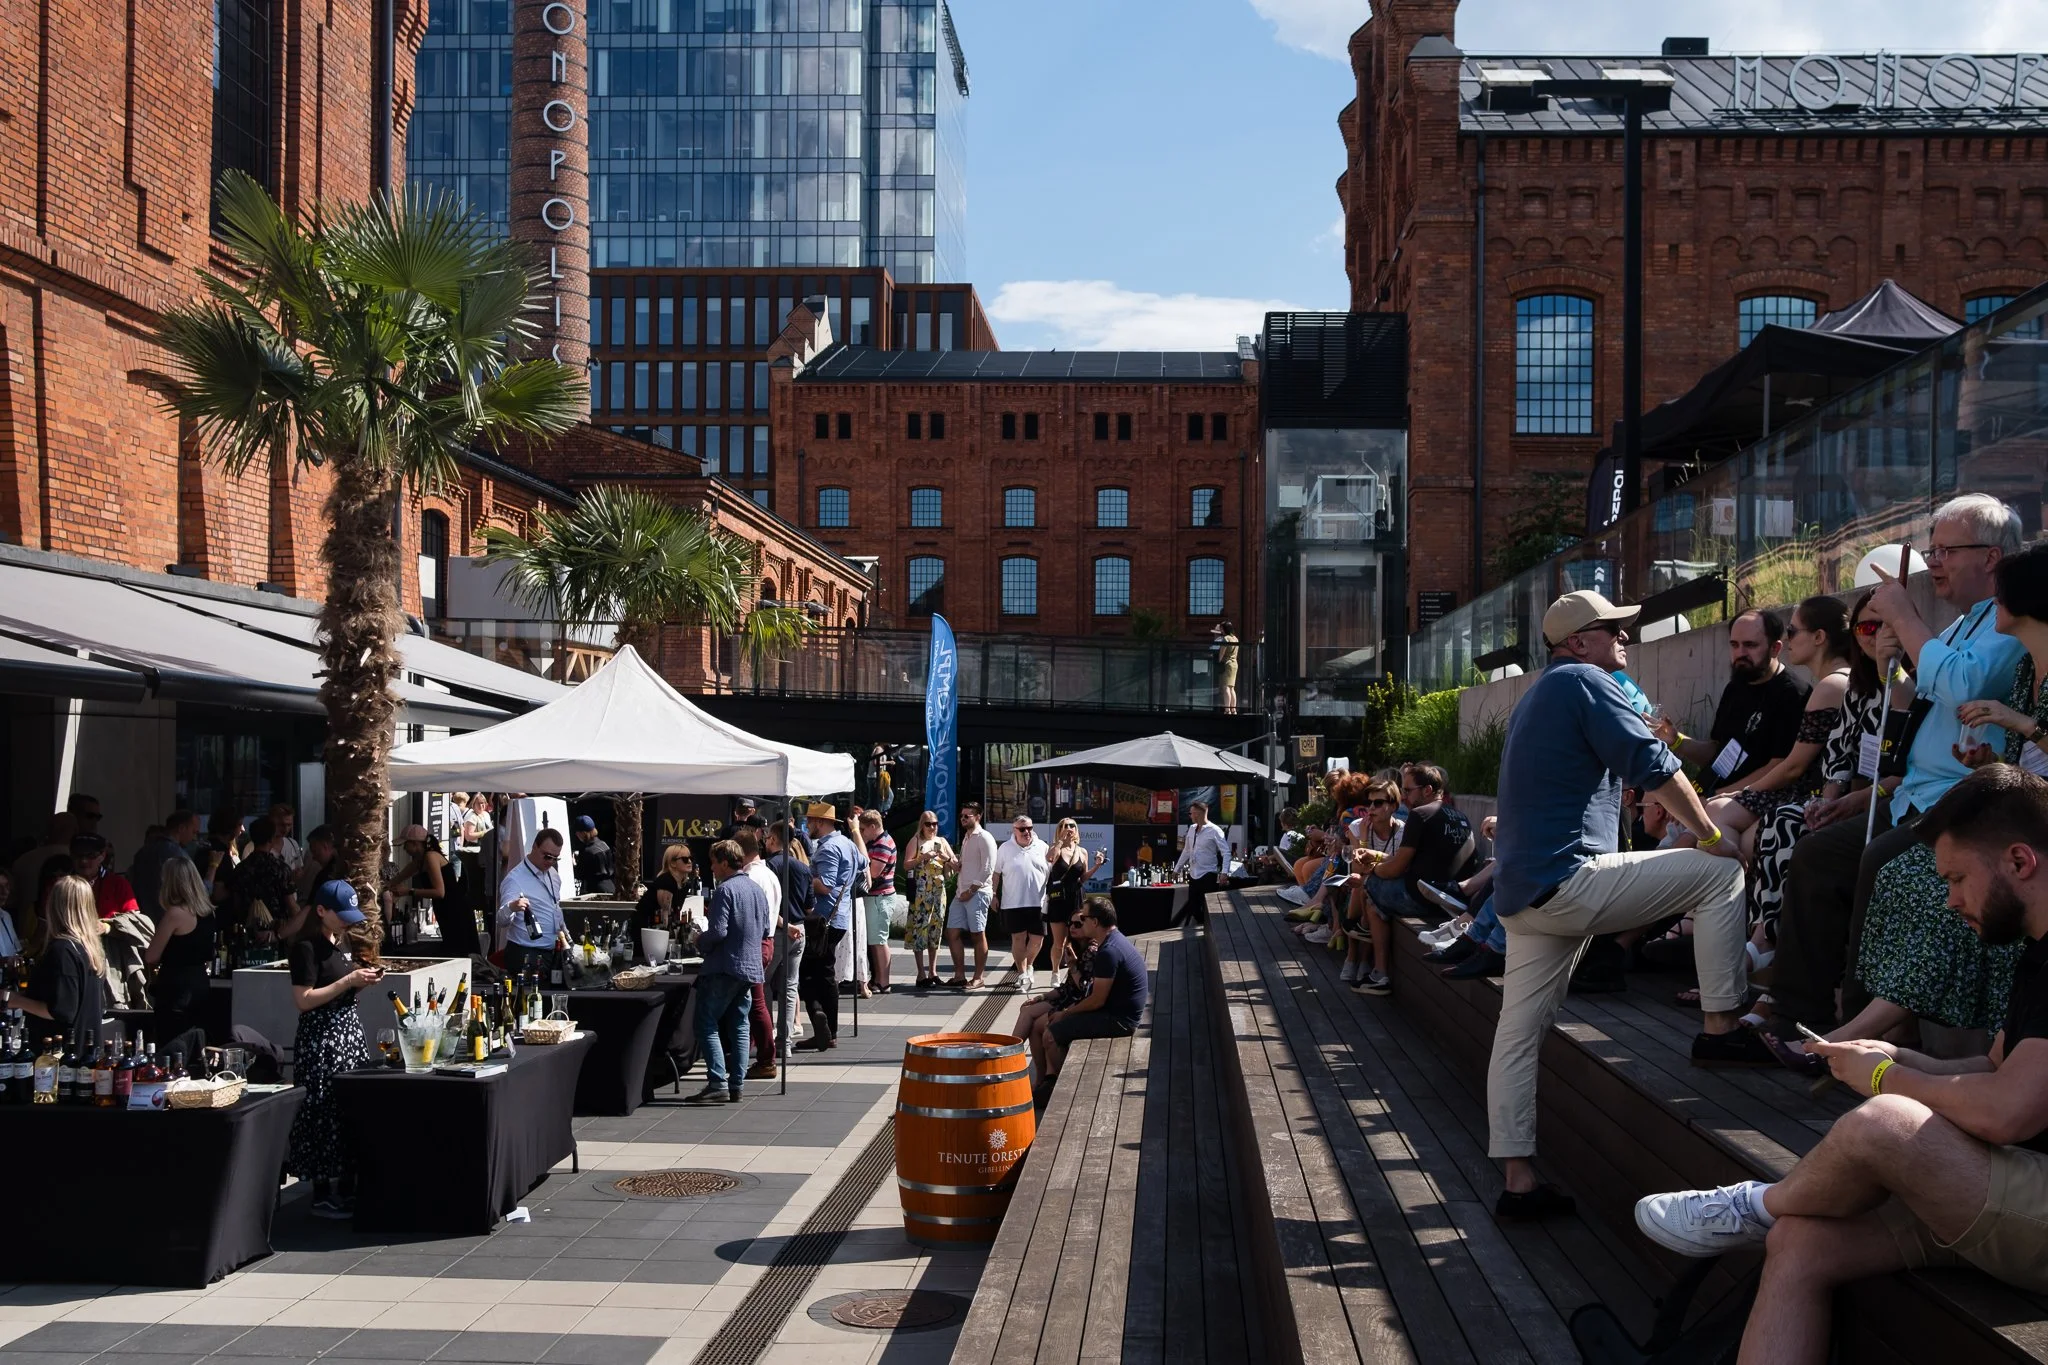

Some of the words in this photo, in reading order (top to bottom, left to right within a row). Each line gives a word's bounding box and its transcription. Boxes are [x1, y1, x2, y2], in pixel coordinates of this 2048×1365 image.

[1734, 52, 2046, 110] MONOP
[663, 818, 723, 839] M&P
[937, 1151, 988, 1165] TENUTE
[991, 1147, 1027, 1163] OREST
[978, 1164, 1014, 1174] GIBELLIN
